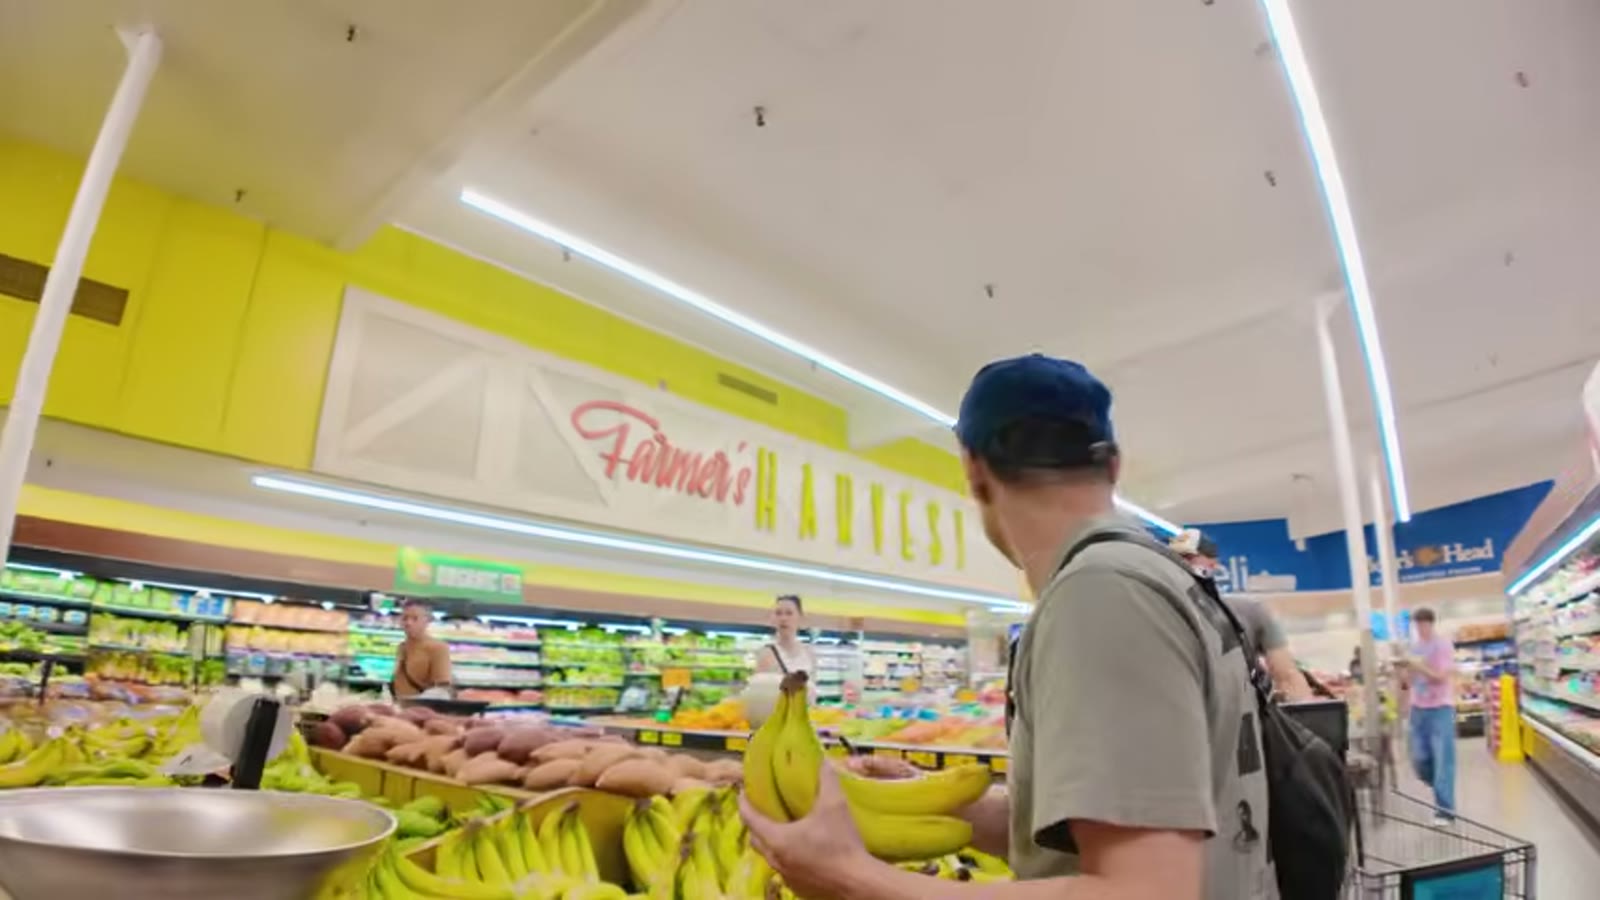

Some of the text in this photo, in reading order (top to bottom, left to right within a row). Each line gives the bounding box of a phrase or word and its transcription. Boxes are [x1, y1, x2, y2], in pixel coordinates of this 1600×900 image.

[570, 400, 752, 506] Farmer's
[1442, 538, 1495, 564] Head
[1212, 555, 1248, 592] eli
